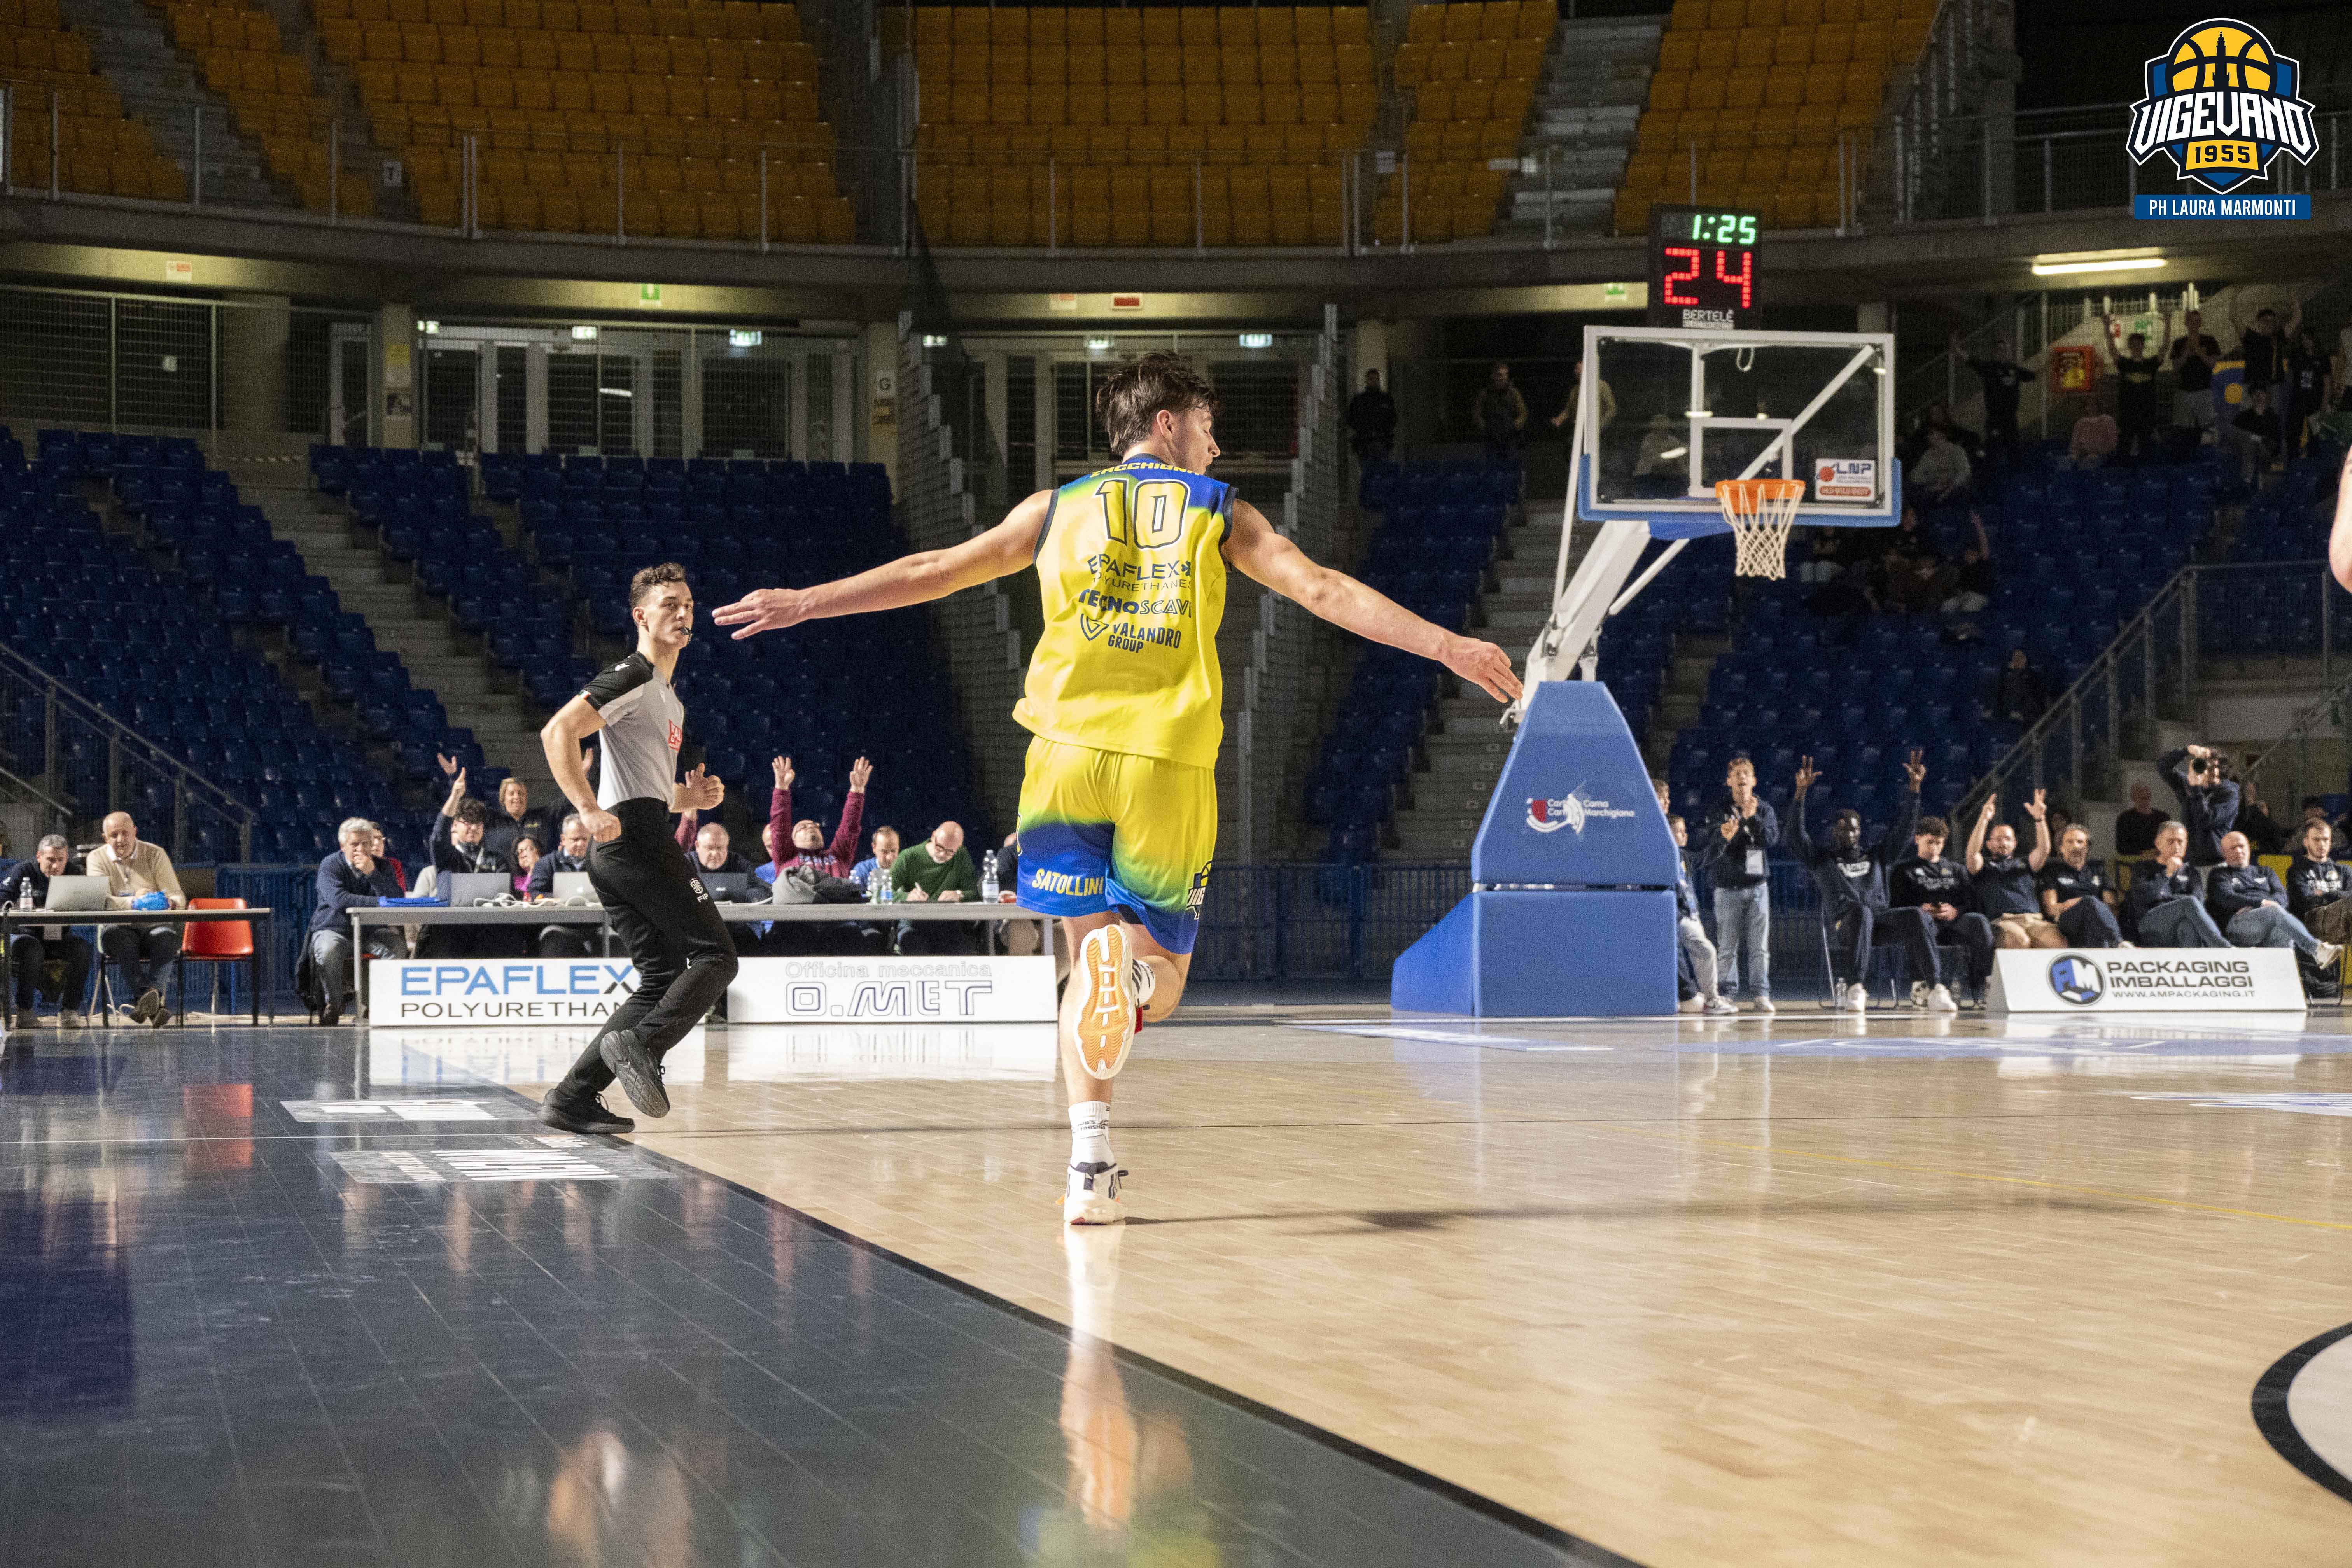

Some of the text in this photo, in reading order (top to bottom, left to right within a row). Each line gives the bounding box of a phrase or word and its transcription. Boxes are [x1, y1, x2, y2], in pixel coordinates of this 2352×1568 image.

[1692, 215, 1756, 244] 1:25
[1664, 247, 1752, 308] 24
[1093, 478, 1191, 551] 10
[1087, 553, 1180, 581] EPAFLEX
[1078, 588, 1191, 618] TECNOSCAVI
[1108, 635, 1143, 653] GROUP
[1113, 622, 1181, 649] VALANDRO
[1032, 868, 1104, 896] SATOLLINI
[697, 893, 708, 902] FIP
[401, 965, 634, 996] EPAFLEX
[785, 961, 992, 977] Officina meccanica
[2106, 961, 2249, 973] PACKAGING
[2110, 976, 2253, 988] IMBALLAGGI
[786, 980, 992, 1016] O.MET
